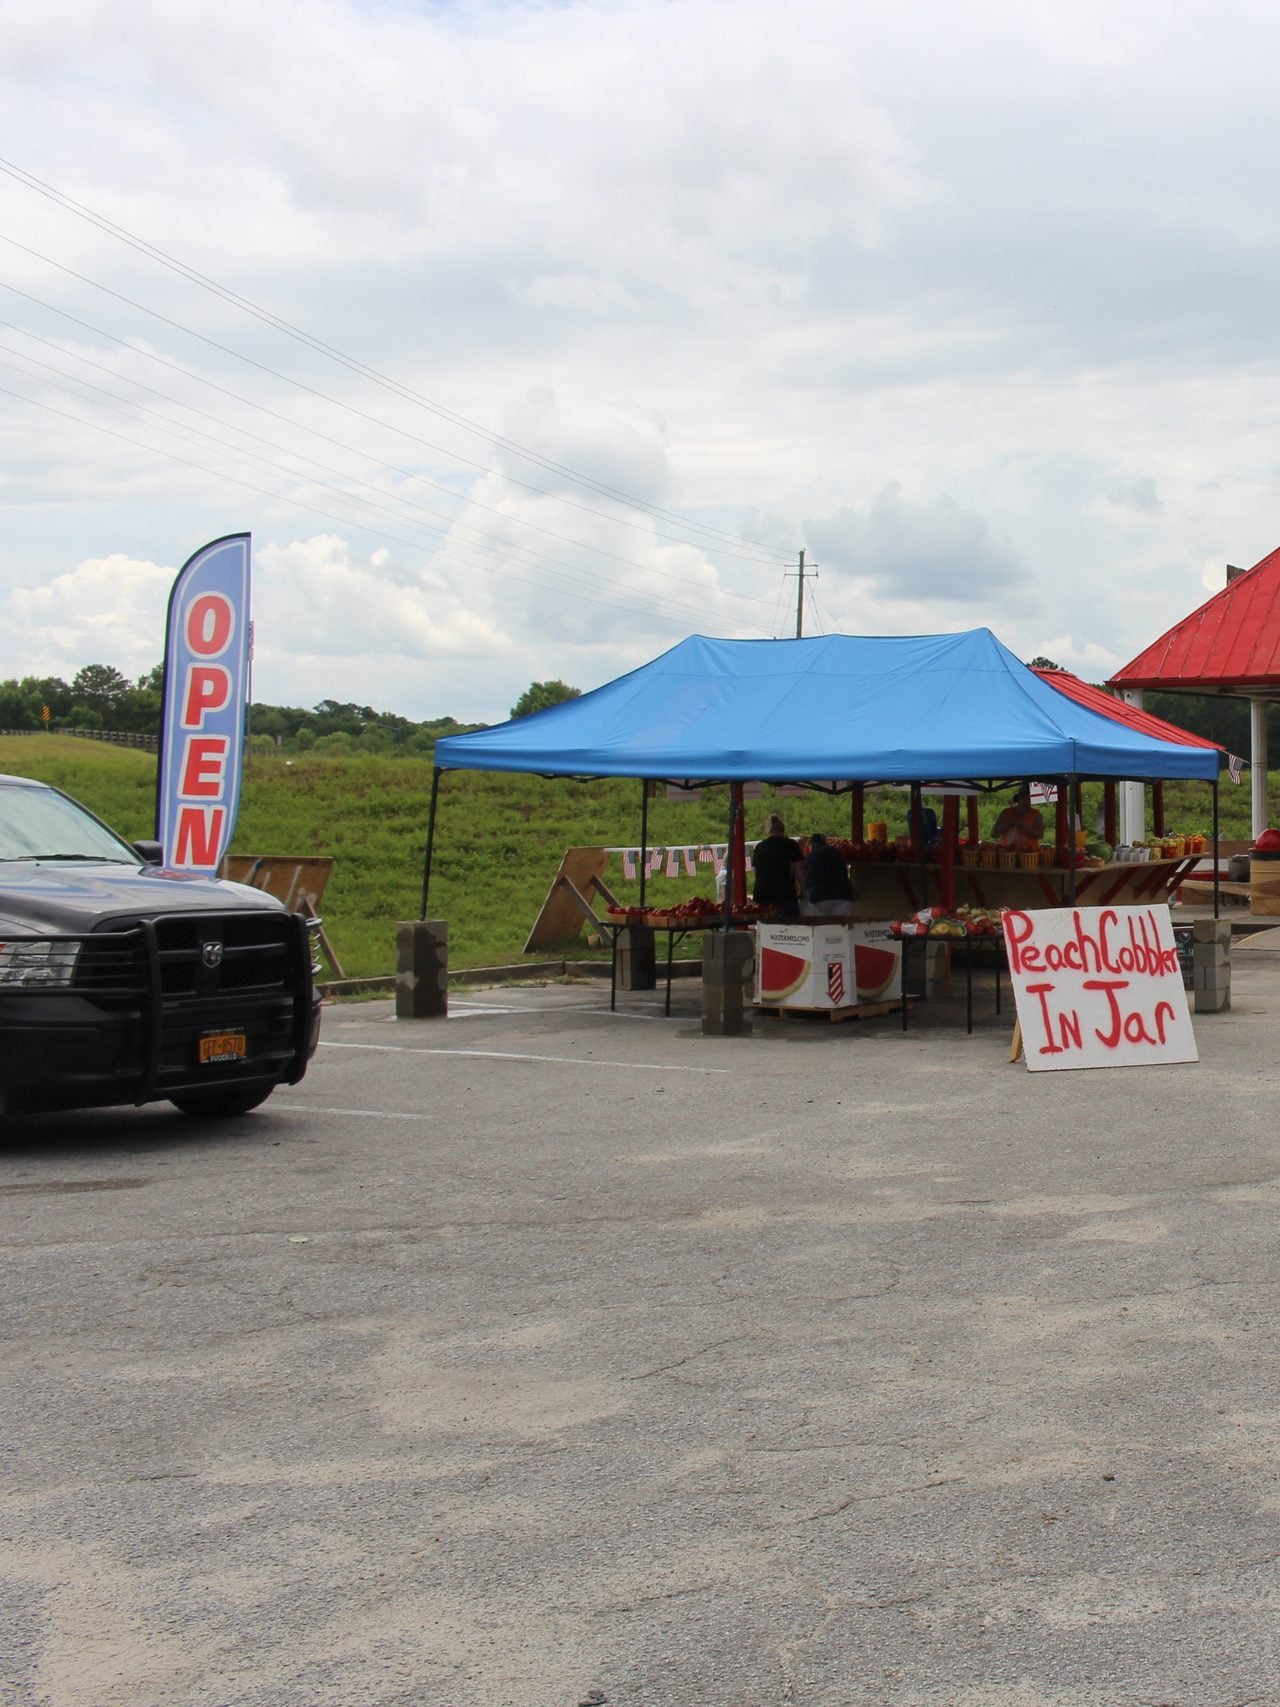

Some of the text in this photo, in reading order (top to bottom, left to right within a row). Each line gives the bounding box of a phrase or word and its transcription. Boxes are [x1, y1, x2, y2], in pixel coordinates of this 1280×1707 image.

[174, 593, 232, 868] OPEN
[769, 934, 810, 942] WATERMELONS
[1083, 980, 1175, 1048] Jar
